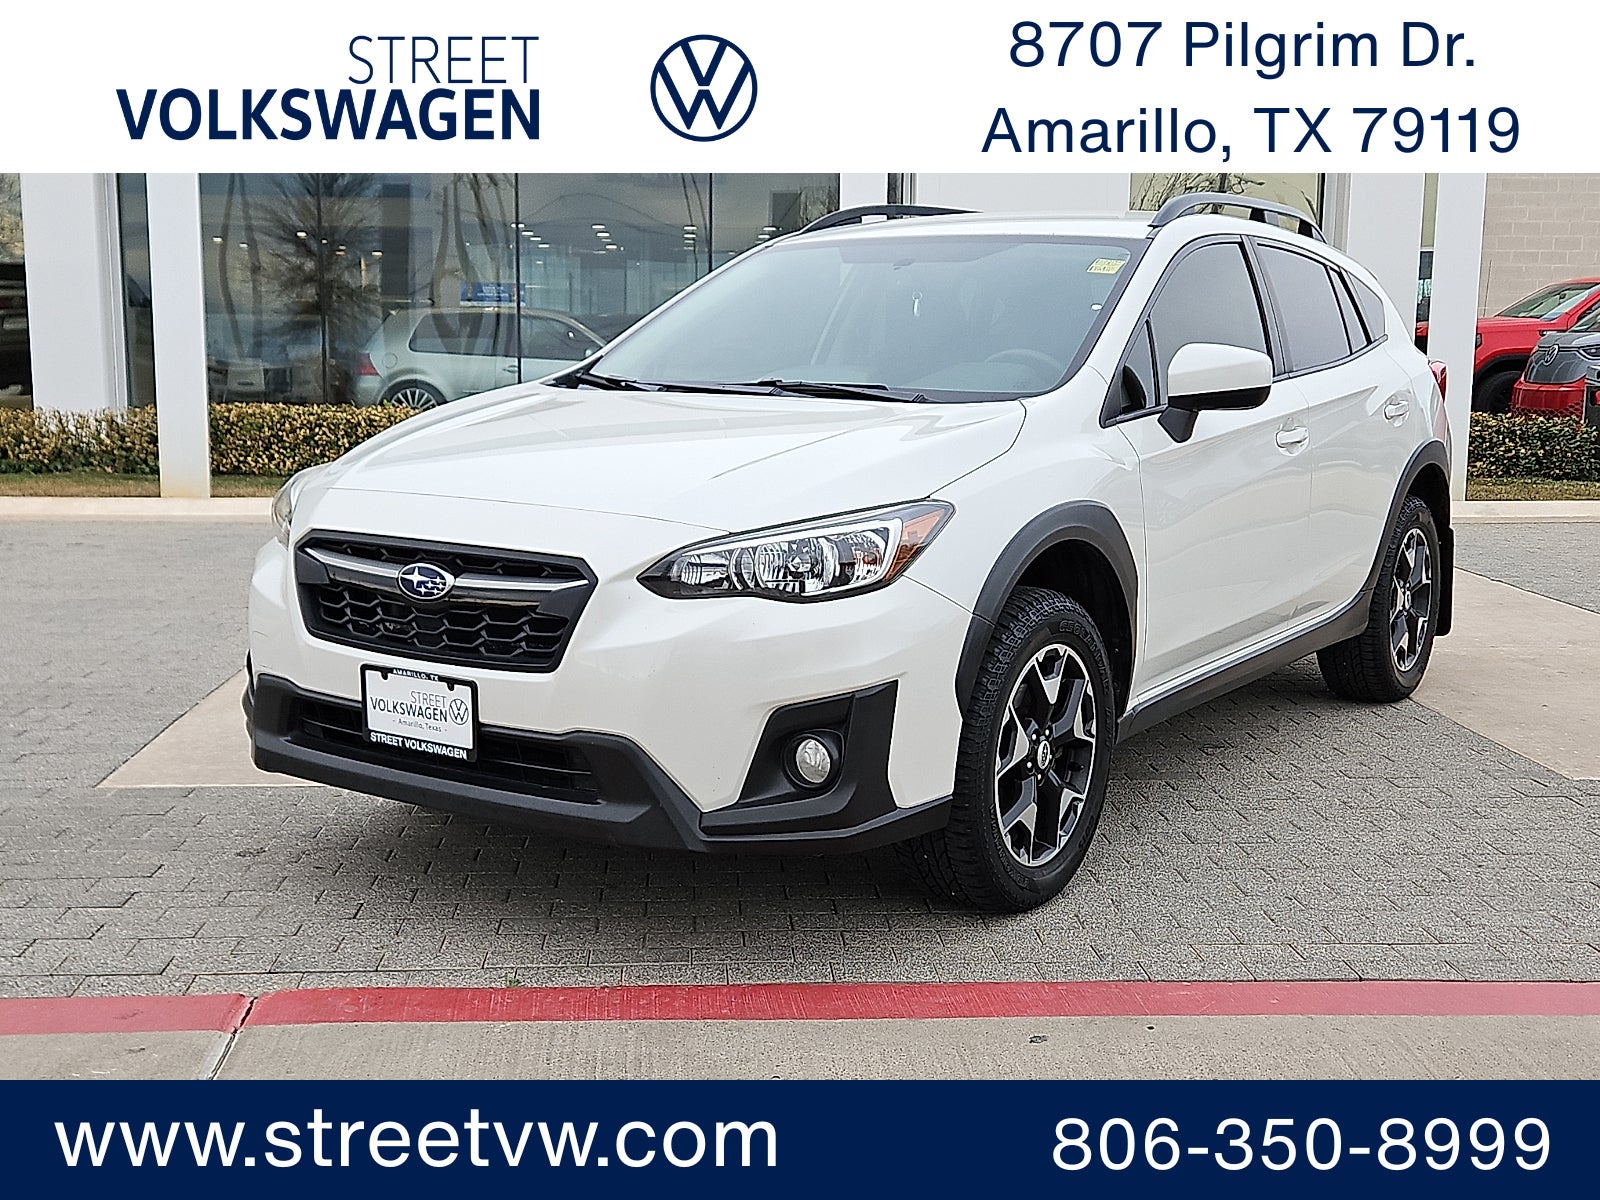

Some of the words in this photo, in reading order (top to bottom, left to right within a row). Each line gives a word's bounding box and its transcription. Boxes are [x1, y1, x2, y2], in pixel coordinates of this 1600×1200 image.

[370, 696, 448, 723] VOLKSWAGEN
[410, 690, 447, 709] STREET
[425, 722, 442, 733] Texas
[370, 731, 403, 748] STREET
[404, 738, 467, 760] VOLKSWAGEN
